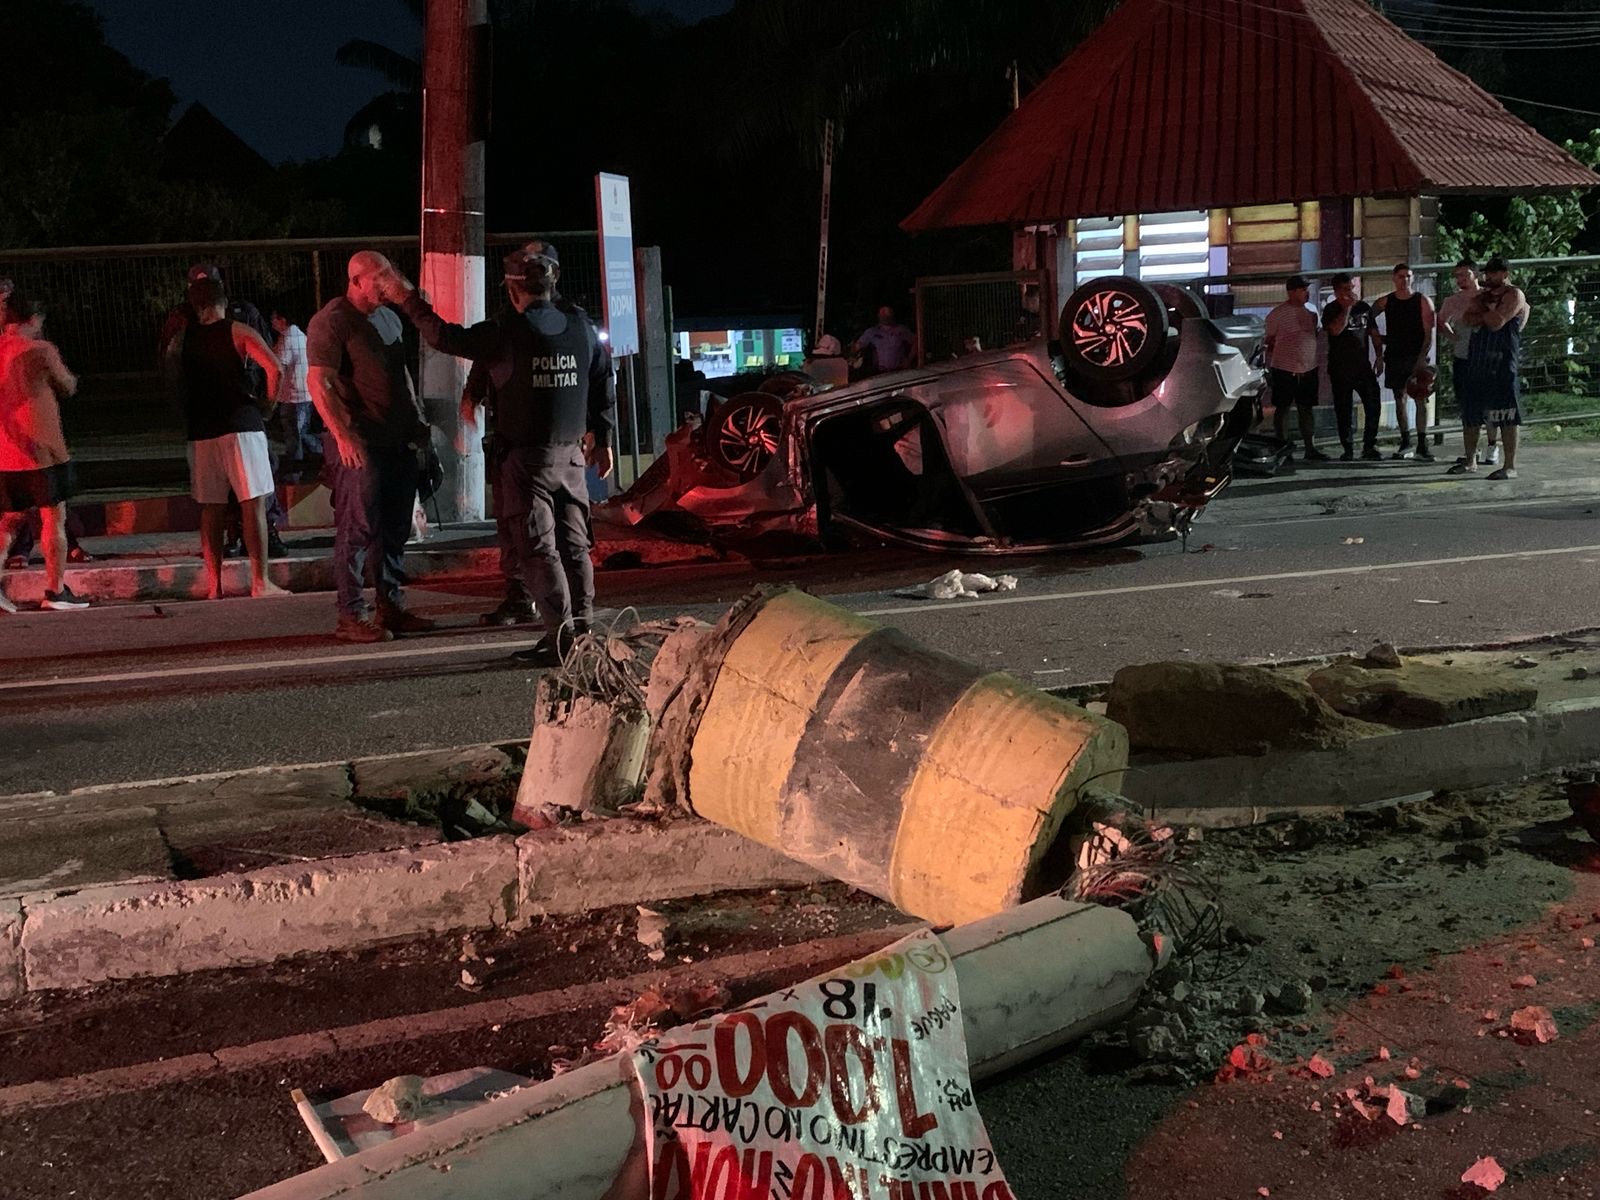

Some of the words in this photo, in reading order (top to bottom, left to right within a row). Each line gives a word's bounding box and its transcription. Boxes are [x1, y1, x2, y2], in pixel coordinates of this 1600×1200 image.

[532, 353, 577, 370] POLÍCIA
[532, 372, 578, 388] MILITAR
[818, 979, 892, 1028] 18
[910, 996, 957, 1040] PAGUE
